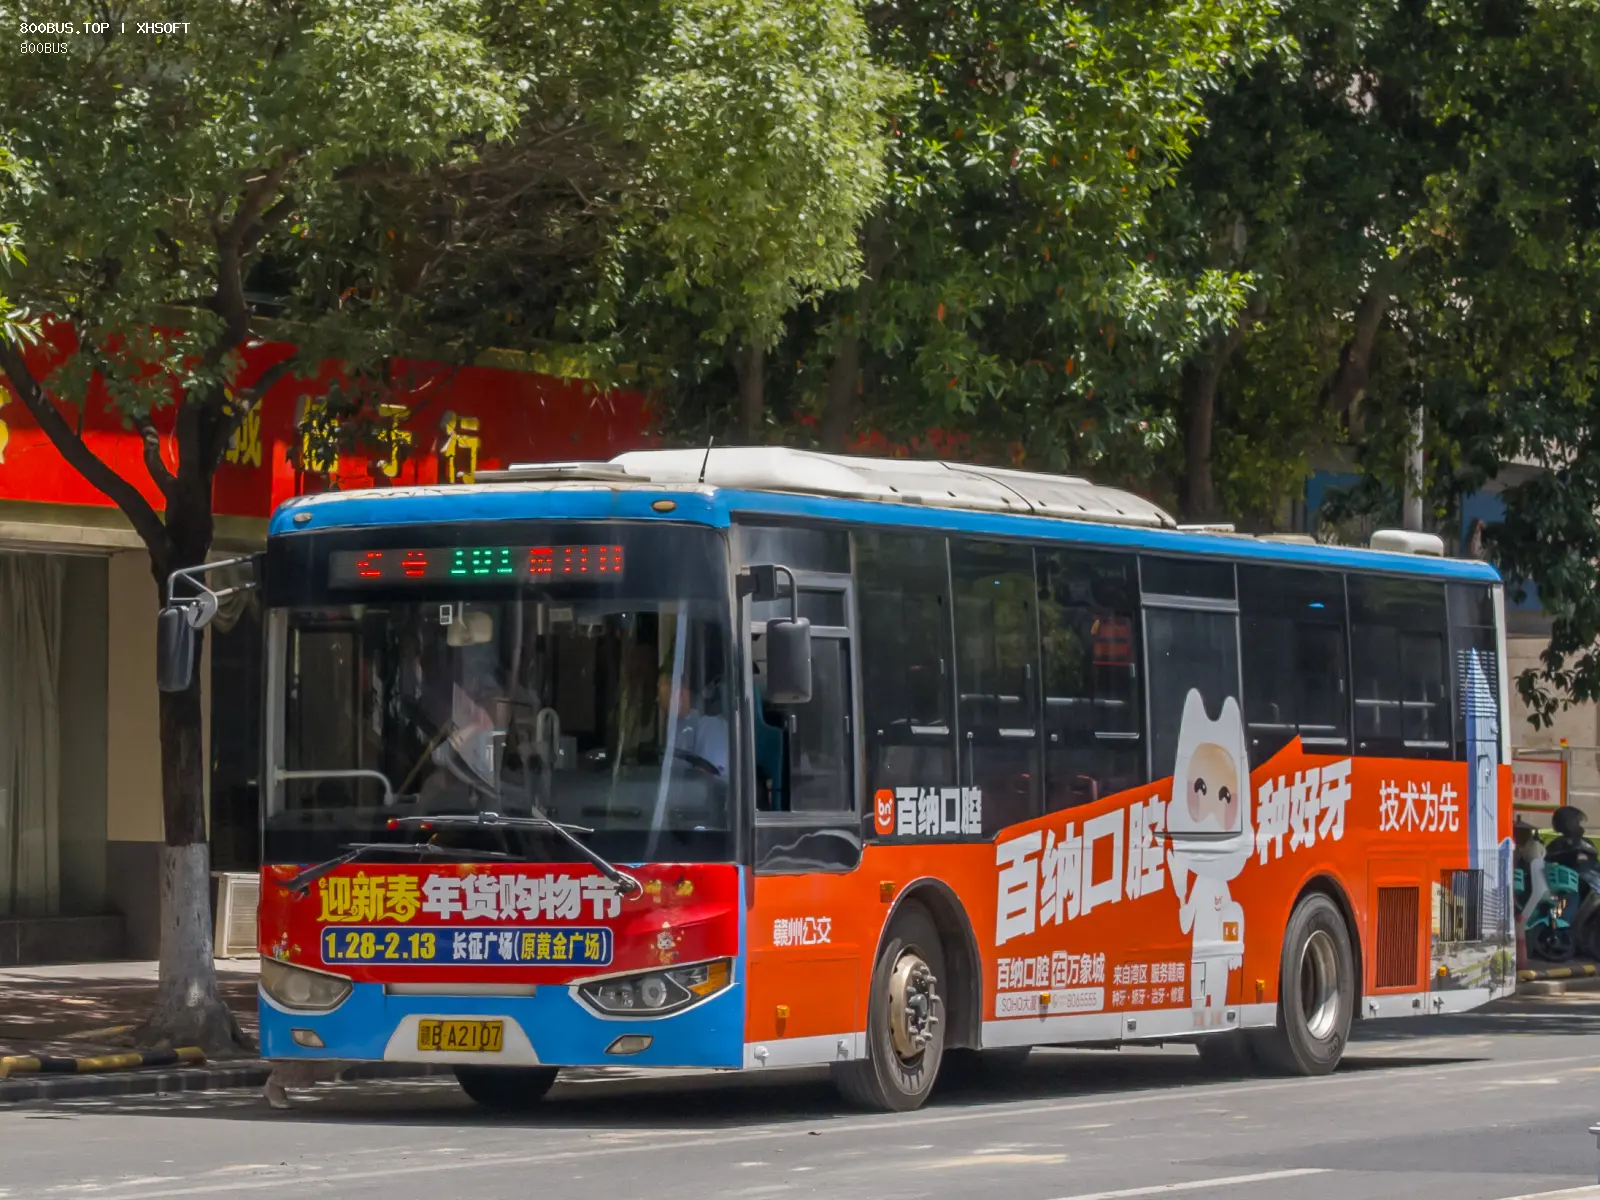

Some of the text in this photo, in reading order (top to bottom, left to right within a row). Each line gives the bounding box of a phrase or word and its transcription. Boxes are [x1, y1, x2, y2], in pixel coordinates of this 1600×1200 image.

[896, 786, 982, 836] 百纳口腔
[1379, 780, 1460, 834] 技术为先
[995, 758, 1352, 946] 百纳口腔 种好牙
[324, 931, 437, 960] 1.28-2.13
[773, 916, 832, 947] 赣州公交
[996, 951, 1106, 990] 百纳口腔在万象城
